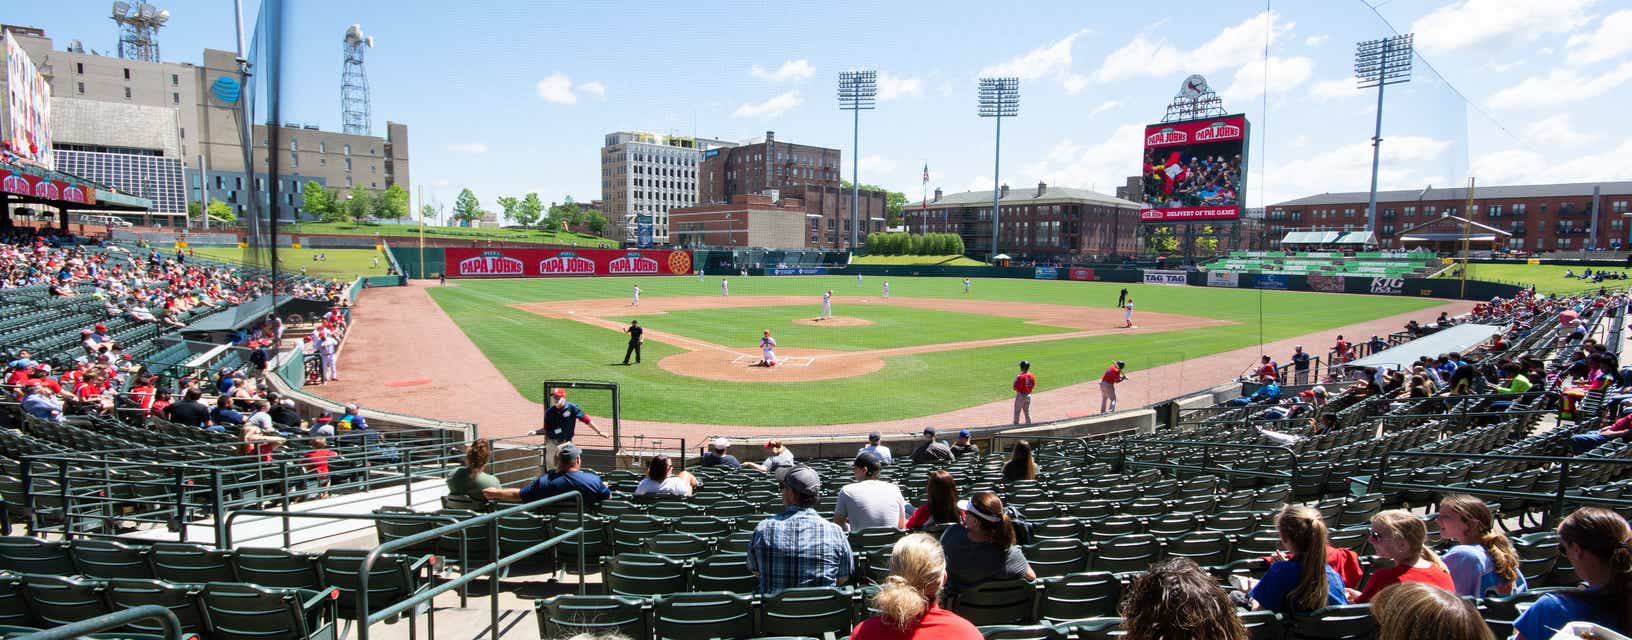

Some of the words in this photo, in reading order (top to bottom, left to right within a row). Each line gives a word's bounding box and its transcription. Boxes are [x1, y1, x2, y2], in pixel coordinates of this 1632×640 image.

[1198, 127, 1214, 139] PAPA
[1216, 126, 1239, 138] JOHNS
[461, 257, 489, 273] PAPA
[490, 257, 522, 273] JOHNS
[541, 257, 564, 273] PAPA
[565, 257, 593, 273] JOHNS
[610, 258, 631, 273] PAPA
[632, 258, 657, 272] JOHNS
[1166, 274, 1185, 282] TAG
